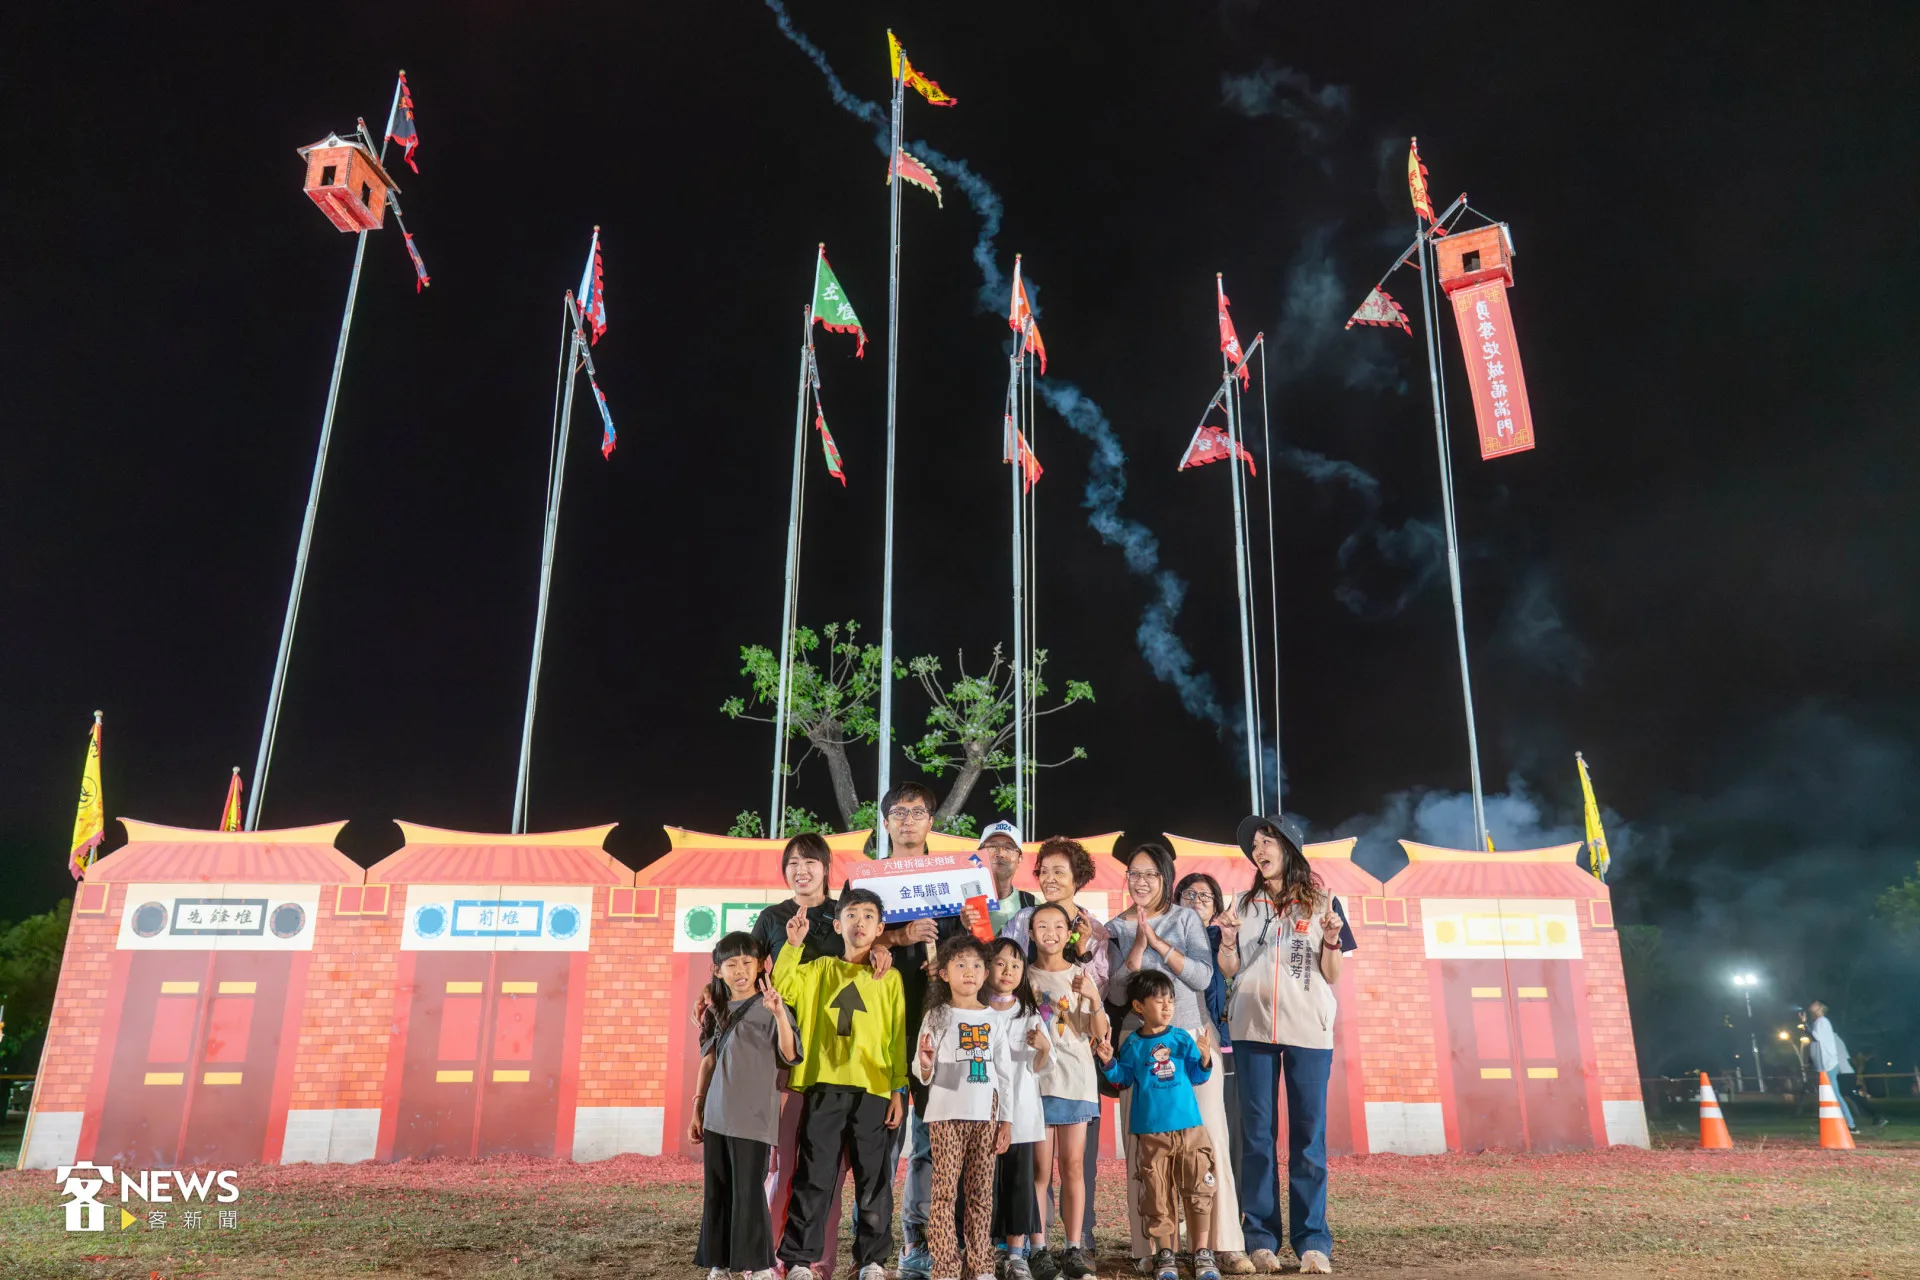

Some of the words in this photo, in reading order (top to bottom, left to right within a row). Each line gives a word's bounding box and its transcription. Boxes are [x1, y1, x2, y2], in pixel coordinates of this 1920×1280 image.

[822, 281, 857, 320] 左堆
[995, 823, 1012, 832] 2024
[884, 855, 955, 871] 六堆祈福尖炮城
[900, 882, 950, 900] 金馬熊讚
[187, 909, 252, 924] 先鋒堆
[480, 909, 519, 926] 前堆
